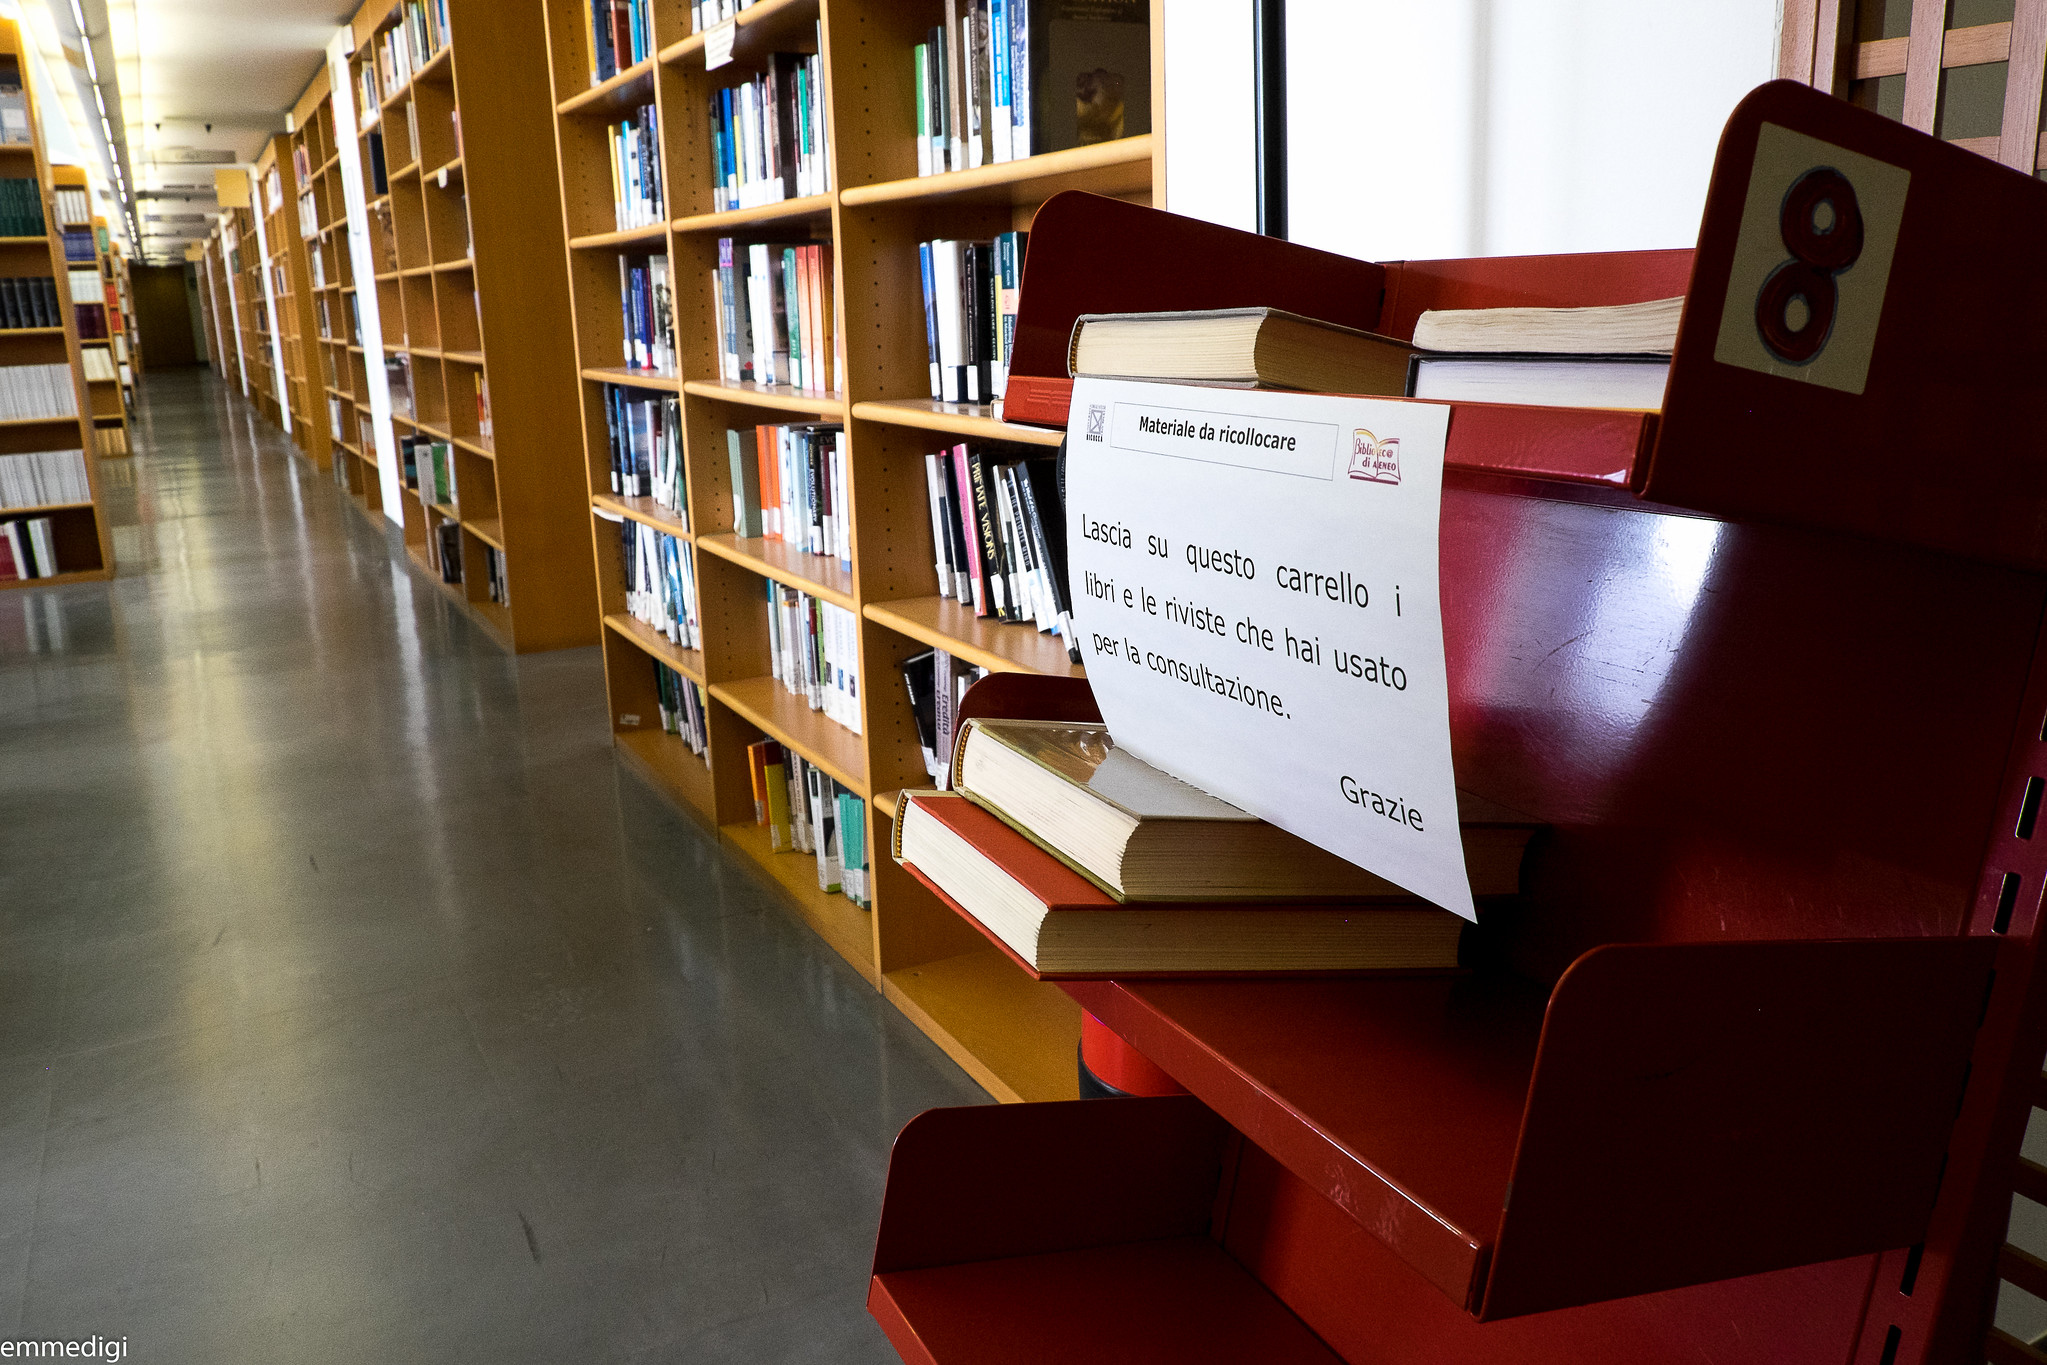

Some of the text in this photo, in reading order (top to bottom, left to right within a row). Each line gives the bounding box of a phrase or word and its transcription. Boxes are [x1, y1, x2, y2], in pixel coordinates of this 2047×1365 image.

[1755, 165, 1864, 367] 8
[1140, 416, 1295, 451] Materiale da ricollocare
[1362, 457, 1371, 468] di
[981, 512, 996, 560] VISIONS
[1083, 514, 1400, 616] Lascia su questo carrello i
[1086, 571, 1407, 691] libri e le riviste che hai usato
[1093, 633, 1290, 719] per la consultazione.
[941, 694, 950, 736] Eredità
[1340, 776, 1424, 831] Grazie
